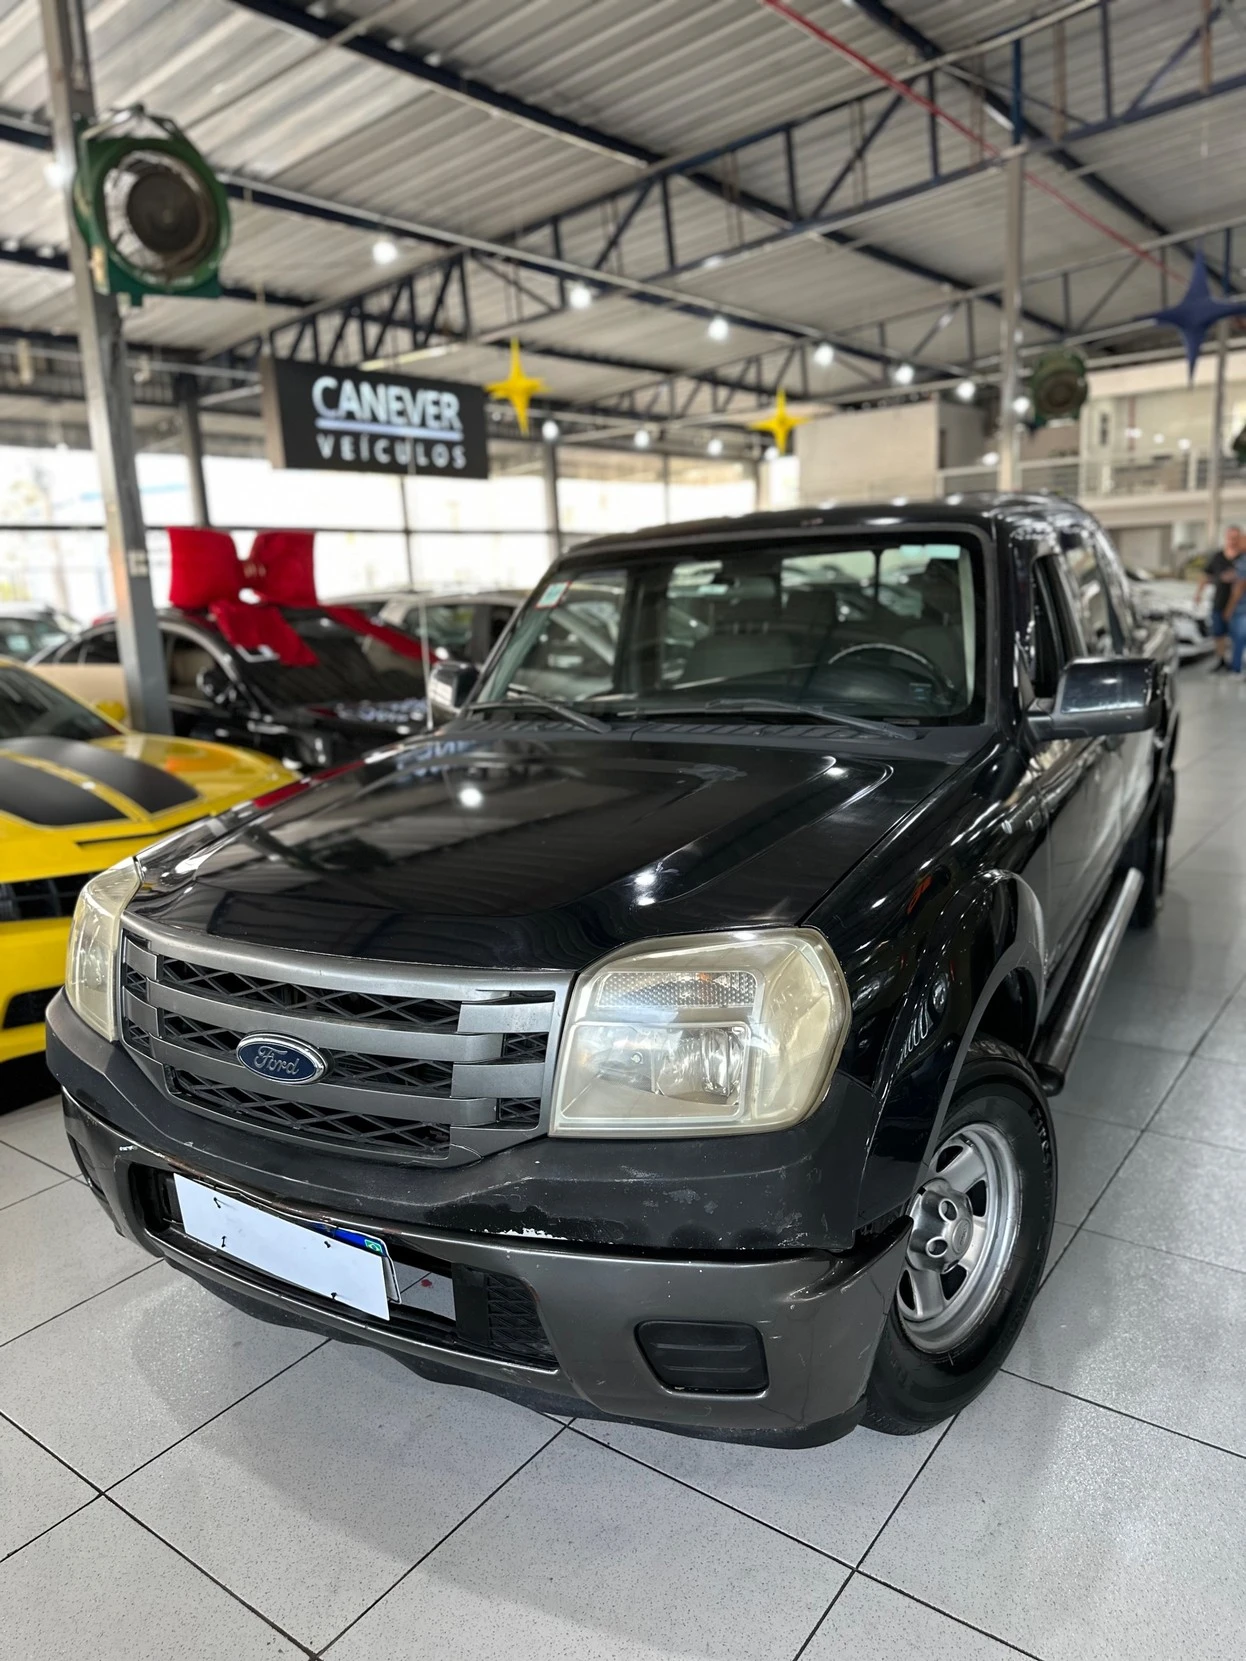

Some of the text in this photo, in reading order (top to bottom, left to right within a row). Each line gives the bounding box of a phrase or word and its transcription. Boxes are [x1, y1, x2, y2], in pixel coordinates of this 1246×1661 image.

[312, 375, 463, 431] CANEVER
[316, 432, 467, 469] VEÍCULOS
[254, 1045, 300, 1075] Ford
